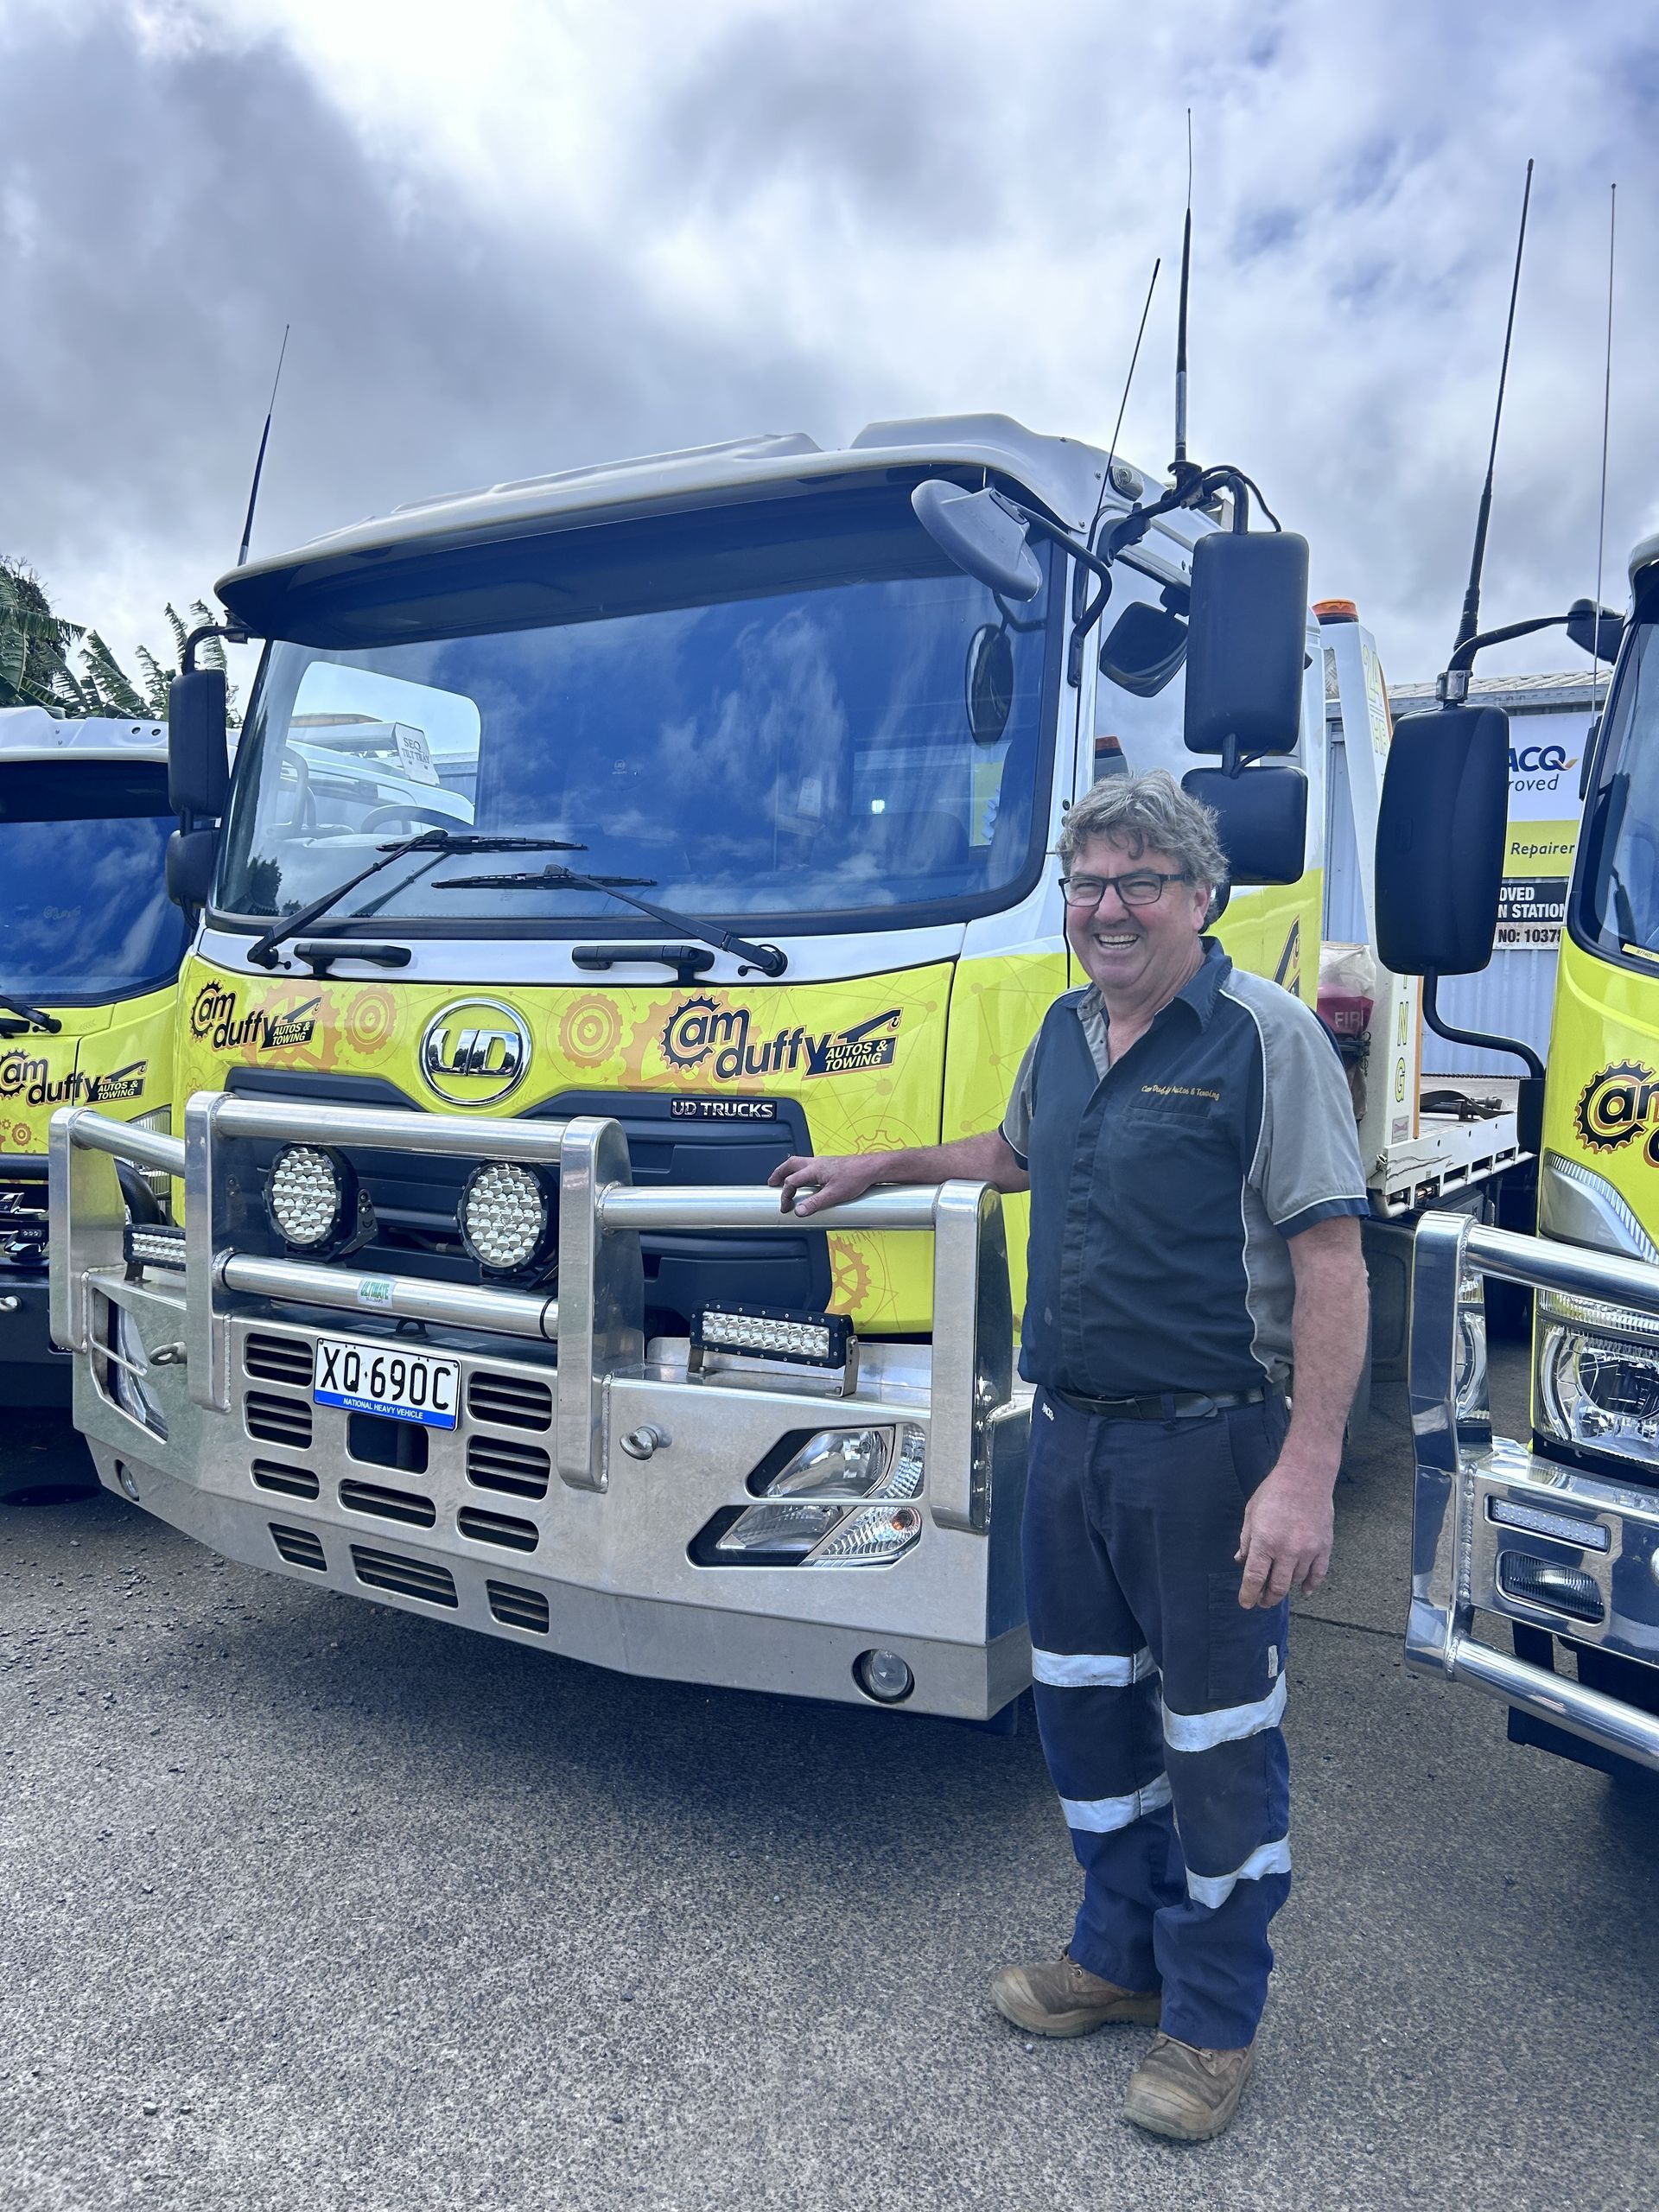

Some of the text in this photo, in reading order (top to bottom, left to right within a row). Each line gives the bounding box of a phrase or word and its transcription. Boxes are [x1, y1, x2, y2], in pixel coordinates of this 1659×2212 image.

[403, 737, 422, 753] SEQ
[402, 747, 415, 760] TILT
[1510, 842, 1574, 858] Repairer
[1498, 929, 1520, 943] NO:
[1335, 1011, 1363, 1028] FIR
[272, 1021, 311, 1036] AUTOS &
[272, 1032, 307, 1046] TOWING
[825, 1039, 888, 1059] AUTOS &
[825, 1053, 882, 1071] TOWING
[98, 1079, 138, 1092] AUTOS &
[98, 1088, 135, 1101] TOWING
[1196, 1089, 1220, 1101] Towing
[672, 1101, 774, 1118] UD TRUCKS
[343, 1397, 423, 1419] NATIONAL HEAVY VEHICLE
